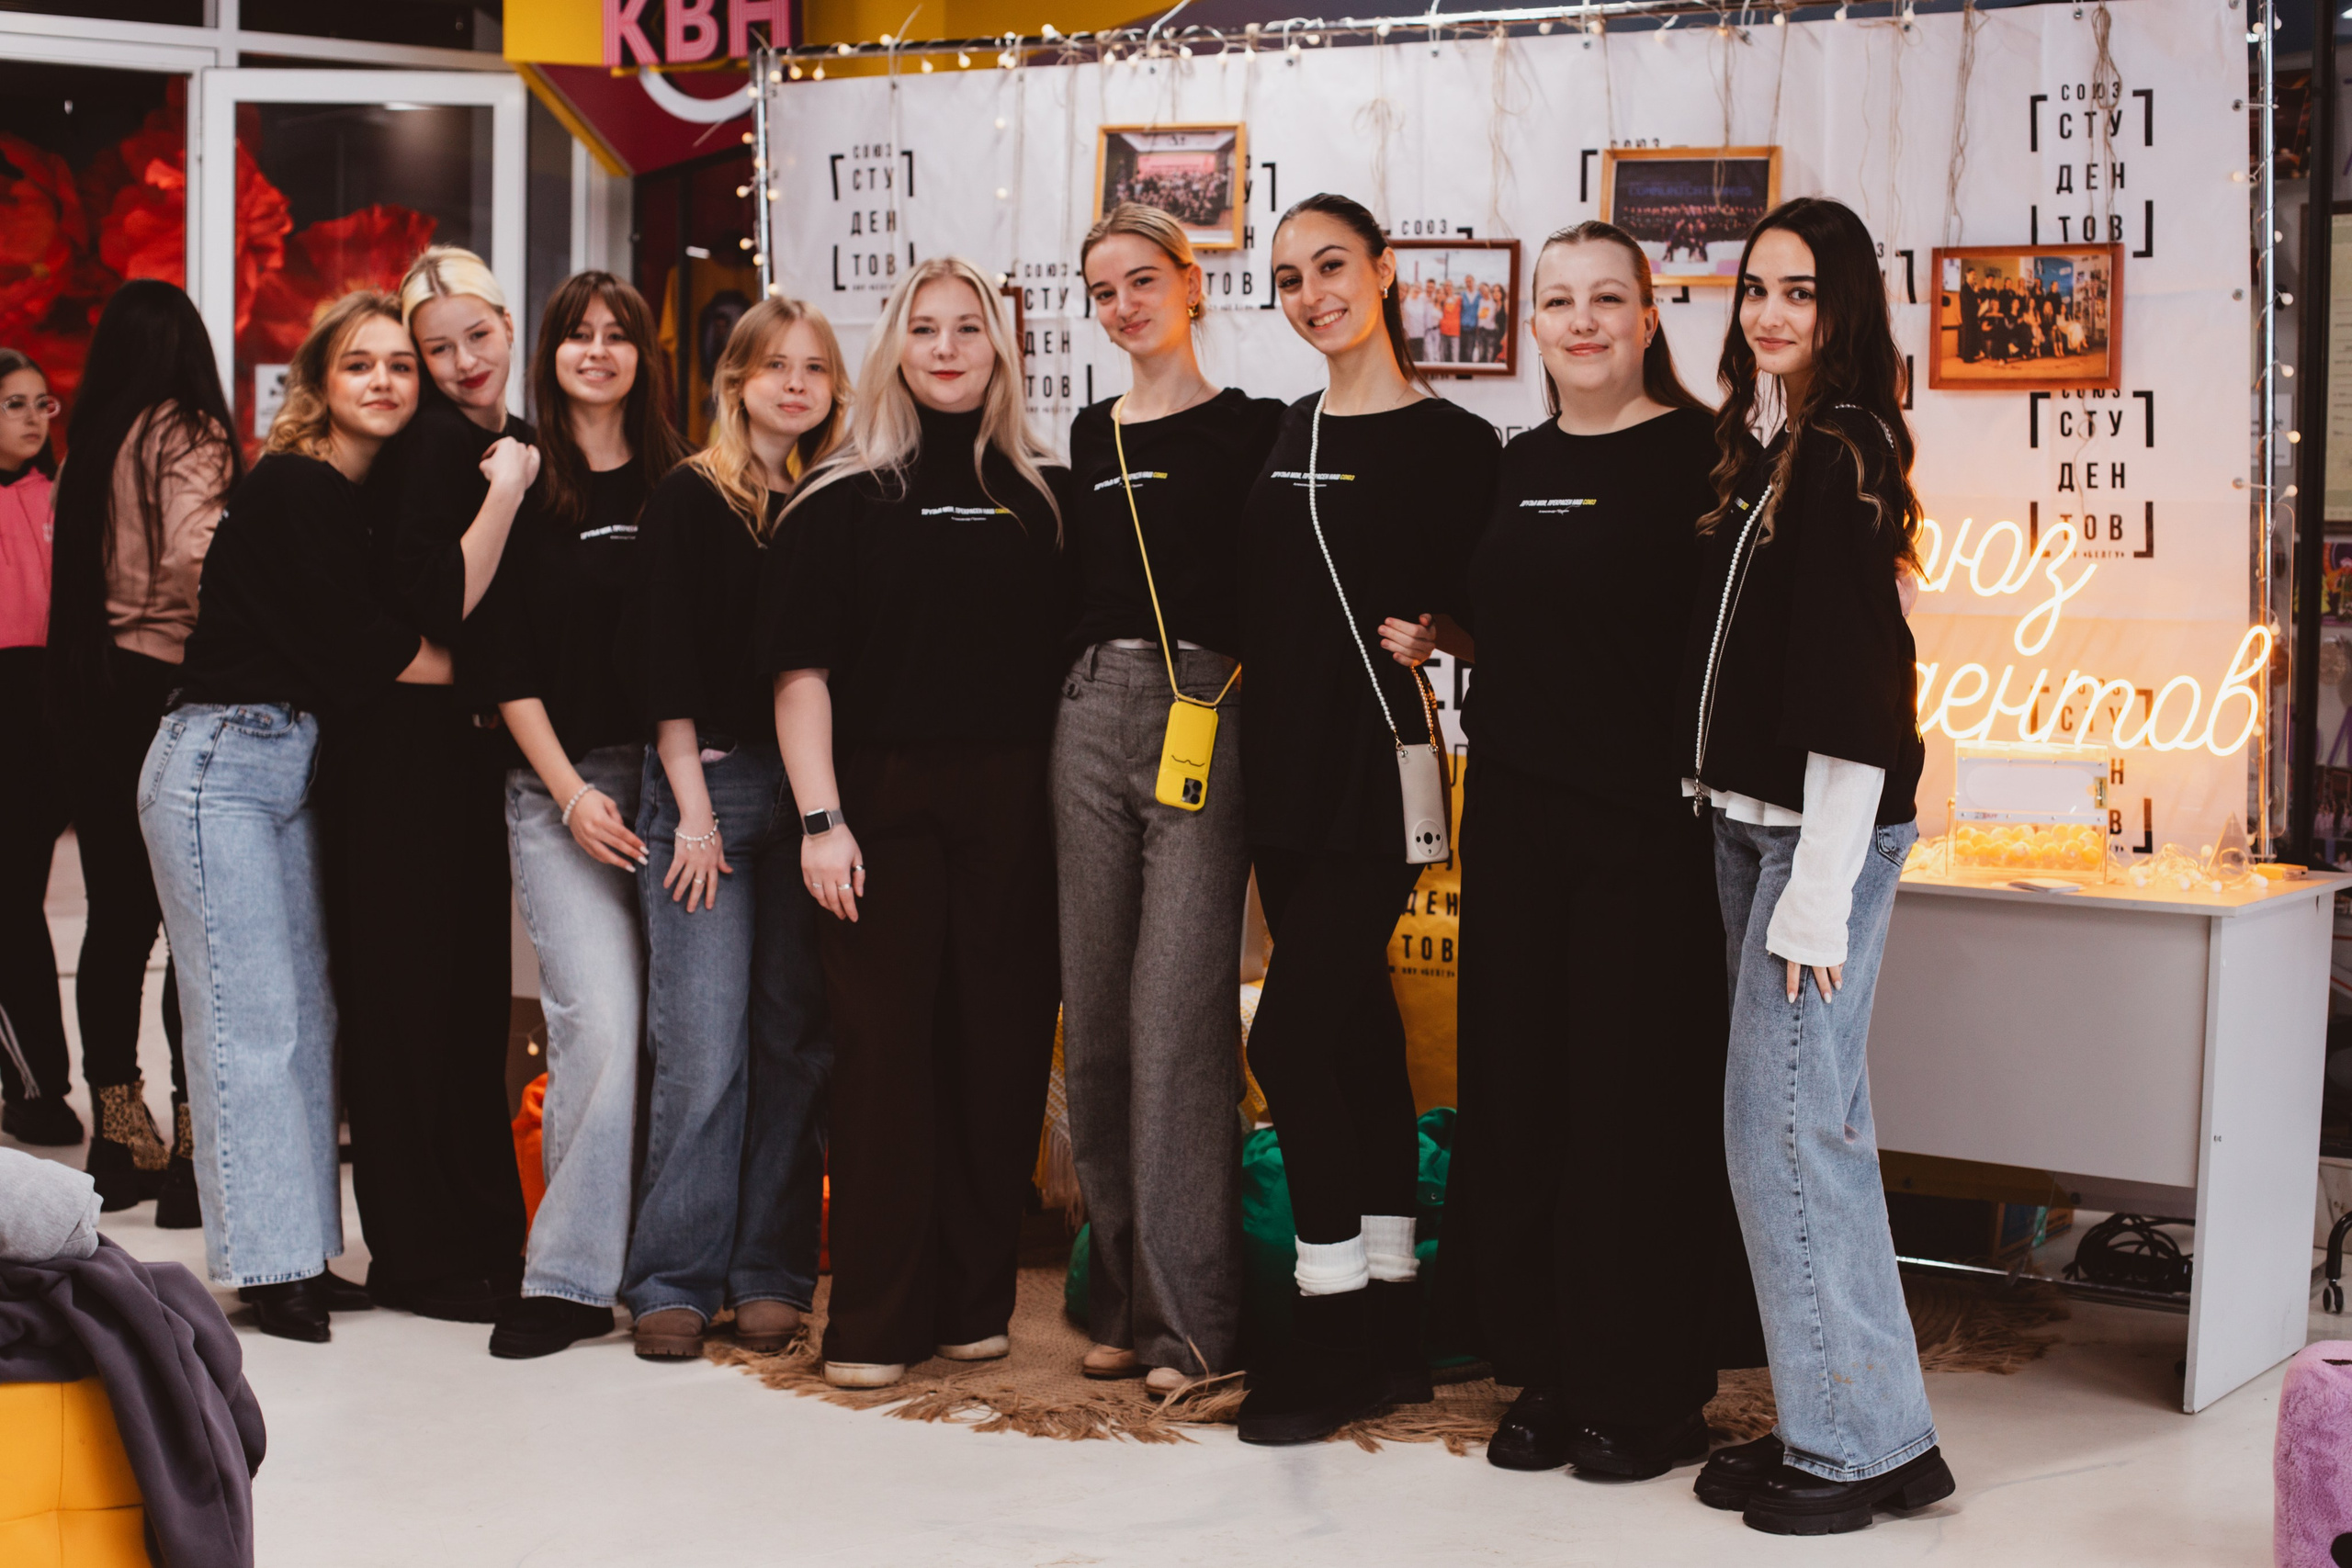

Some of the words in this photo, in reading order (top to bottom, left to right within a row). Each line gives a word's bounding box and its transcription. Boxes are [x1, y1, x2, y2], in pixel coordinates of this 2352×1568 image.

[2061, 82, 2122, 101] СОЮЗ
[2059, 109, 2123, 140] СТУ
[853, 143, 891, 159] СОЮЗ
[853, 166, 894, 191] СТУ
[2056, 162, 2125, 195] ДЕН
[850, 210, 897, 236] ДЕН
[2058, 213, 2123, 243] ТОВ
[852, 253, 896, 276] ТОВ
[1024, 263, 1069, 276] СОЮЗ
[1206, 272, 1253, 295] ТОВ
[1024, 288, 1069, 310] СТУ
[1023, 332, 1070, 356] ДЕН
[1025, 376, 1070, 398] ТОВ
[2060, 411, 2123, 438] СТУ
[2058, 462, 2126, 492] ДЕН
[1917, 517, 2098, 658] оюз
[1401, 934, 1453, 963] ТОВ
